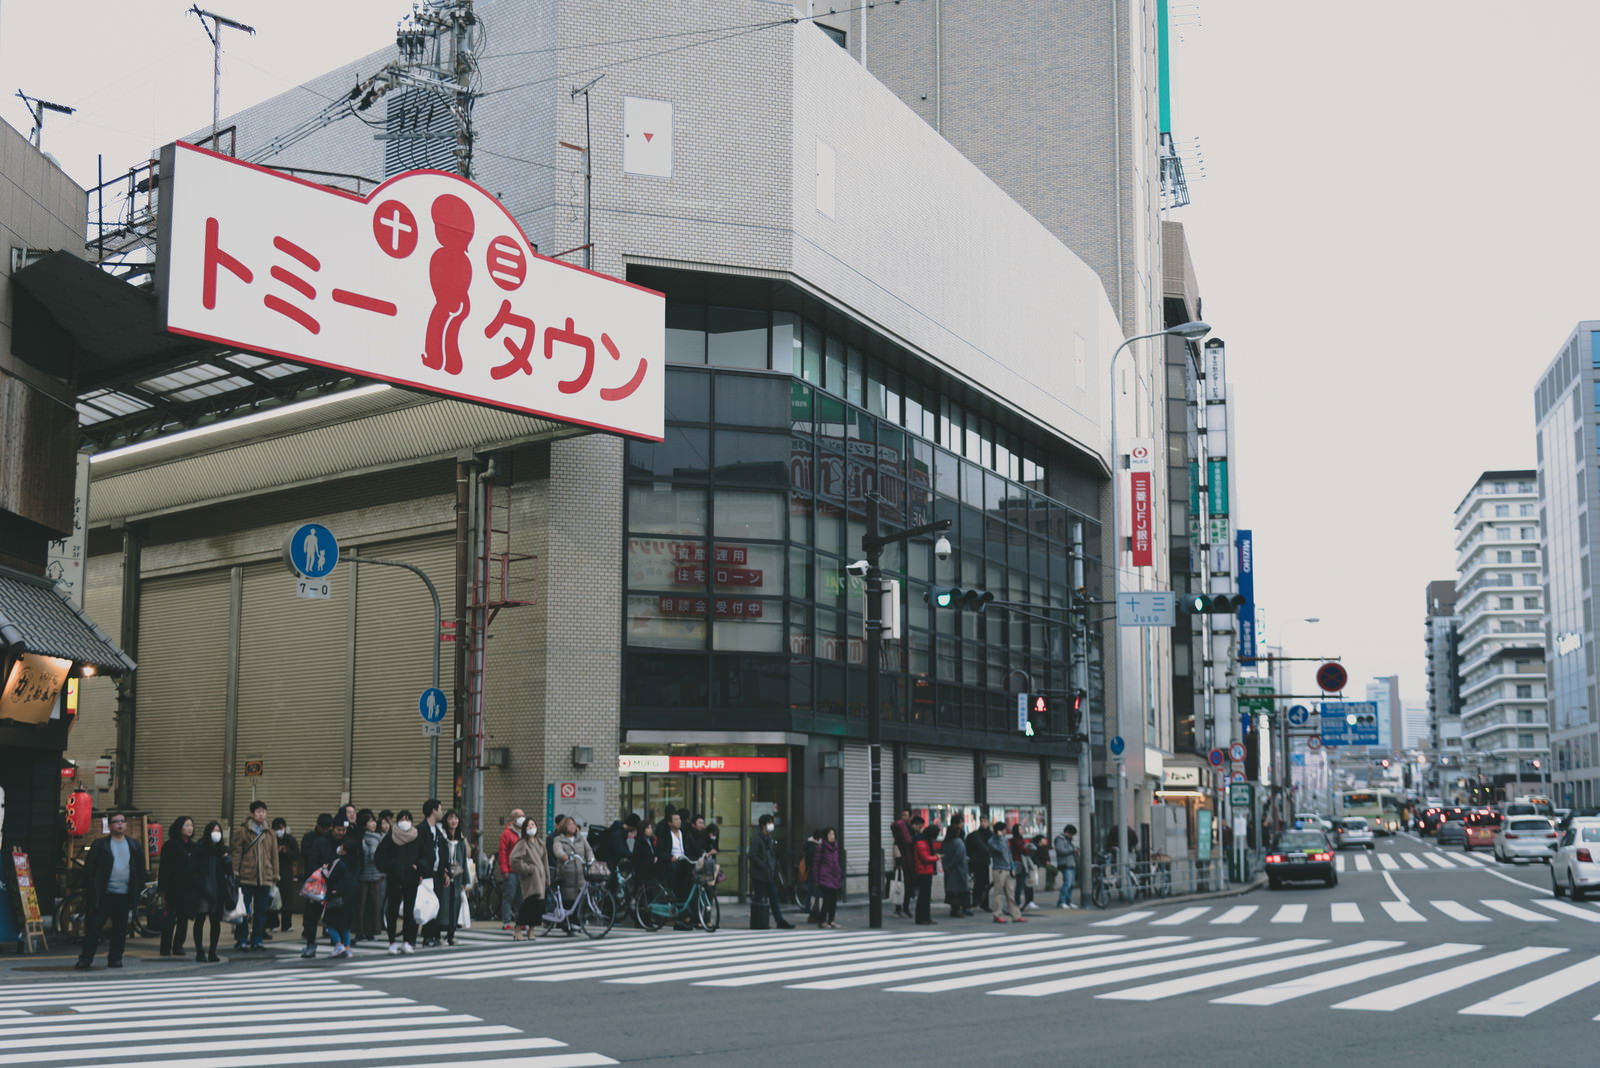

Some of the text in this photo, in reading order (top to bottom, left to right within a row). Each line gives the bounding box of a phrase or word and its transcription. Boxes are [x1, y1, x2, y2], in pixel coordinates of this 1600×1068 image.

[379, 208, 414, 251] 十
[490, 241, 523, 286] 三
[202, 216, 648, 402] トミー タウン
[678, 547, 745, 562] 資産運用
[1243, 539, 1251, 573] MIZUHO
[677, 569, 760, 583] 住宅ローン
[662, 599, 760, 614] 相談会受付中
[1125, 596, 1166, 612] 十三
